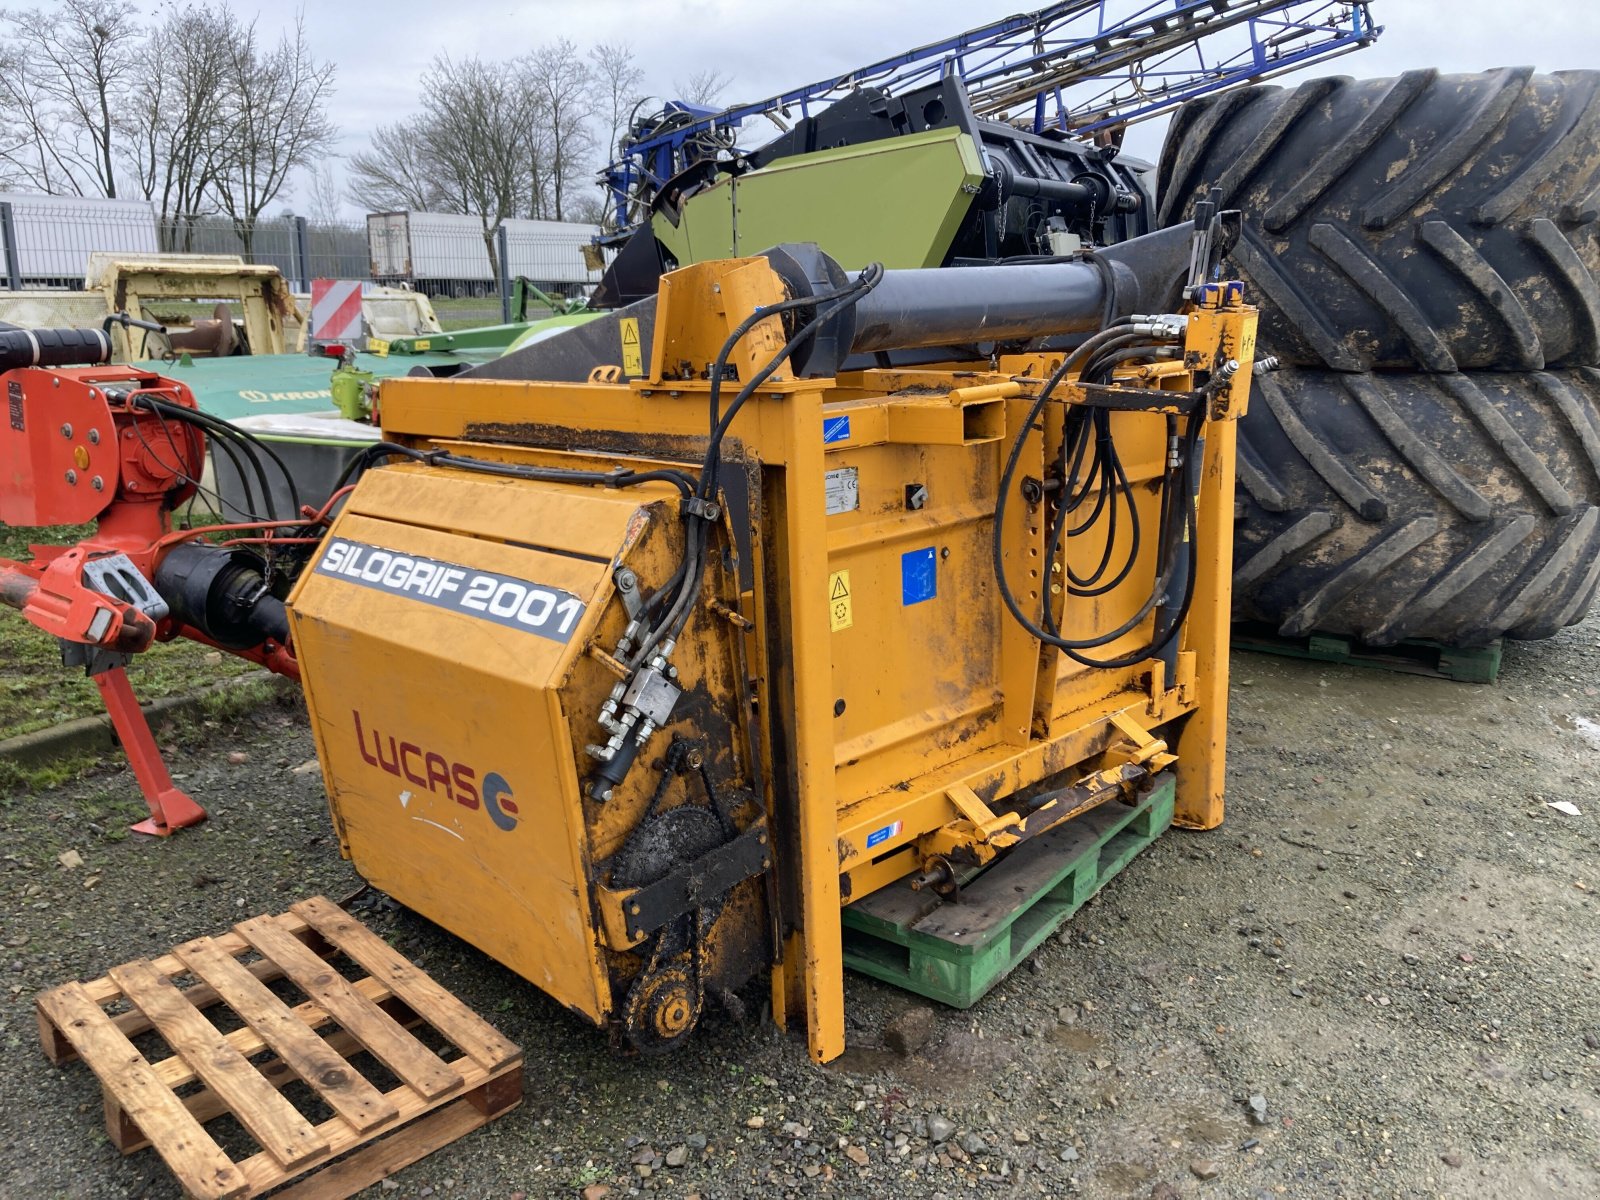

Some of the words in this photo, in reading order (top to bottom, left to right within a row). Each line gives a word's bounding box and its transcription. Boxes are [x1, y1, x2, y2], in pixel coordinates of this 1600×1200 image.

[271, 389, 332, 401] KRON
[321, 542, 467, 598] SILOGRIF
[459, 576, 583, 634] 2001
[352, 709, 480, 811] LUCAS
